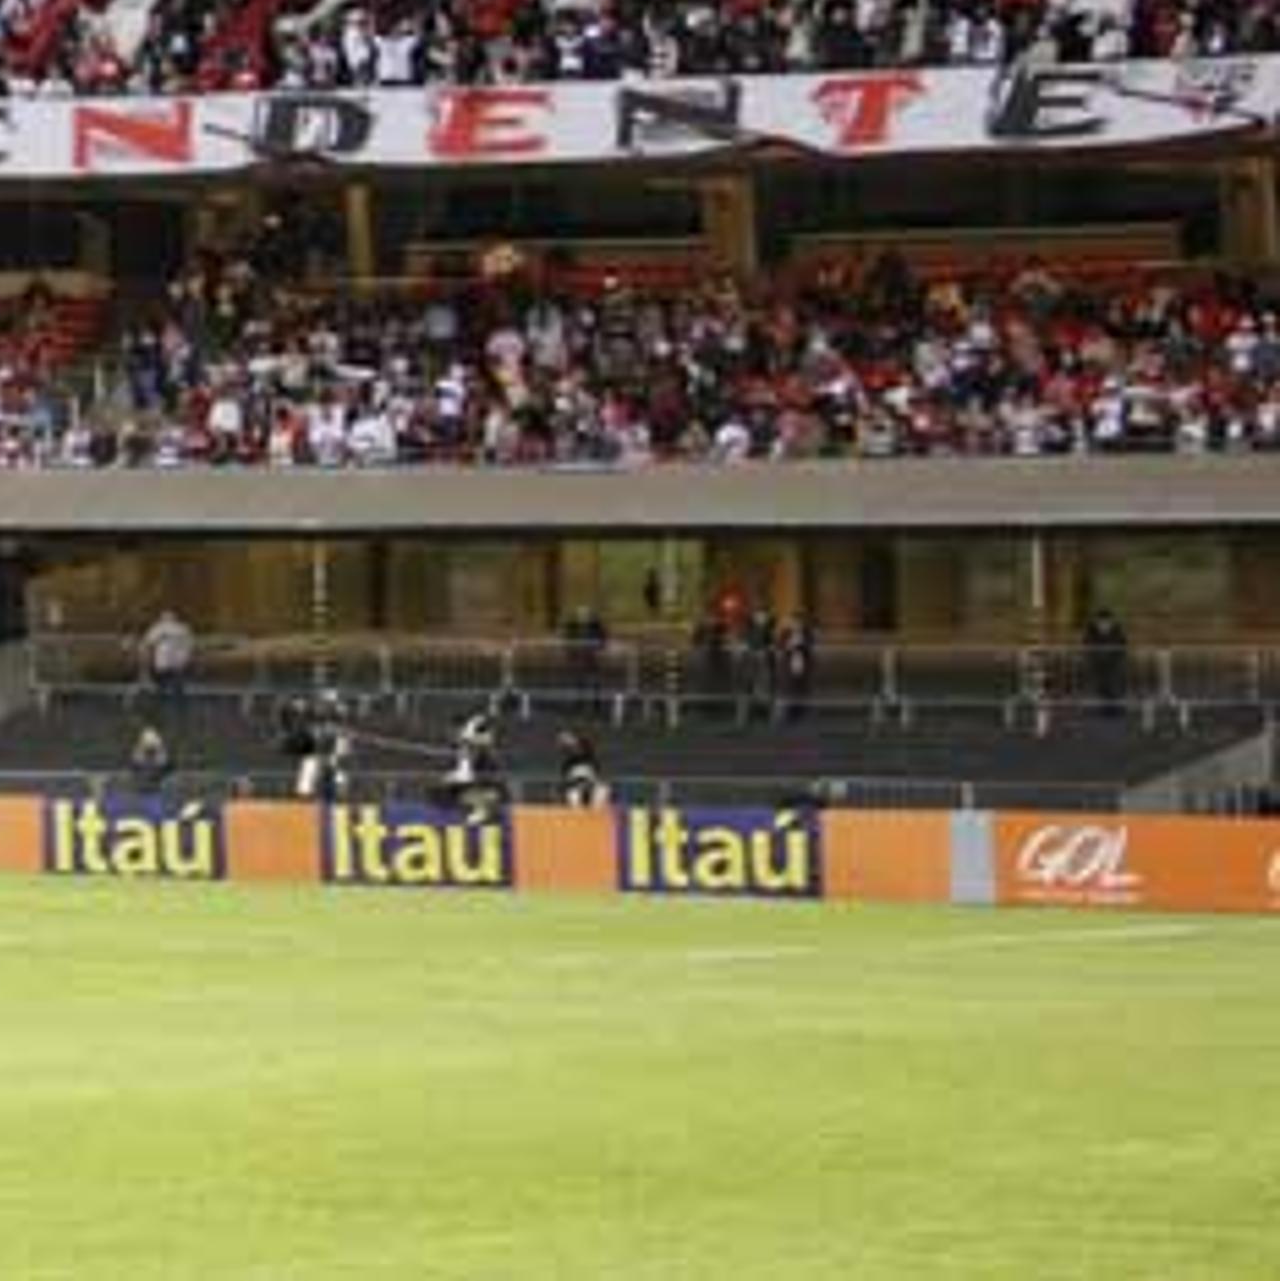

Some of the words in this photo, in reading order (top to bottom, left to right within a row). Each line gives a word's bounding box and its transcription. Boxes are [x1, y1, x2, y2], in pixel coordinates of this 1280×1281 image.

[55, 800, 213, 876] Itaú
[333, 804, 503, 882] Itaú
[629, 807, 809, 889] Itaú
